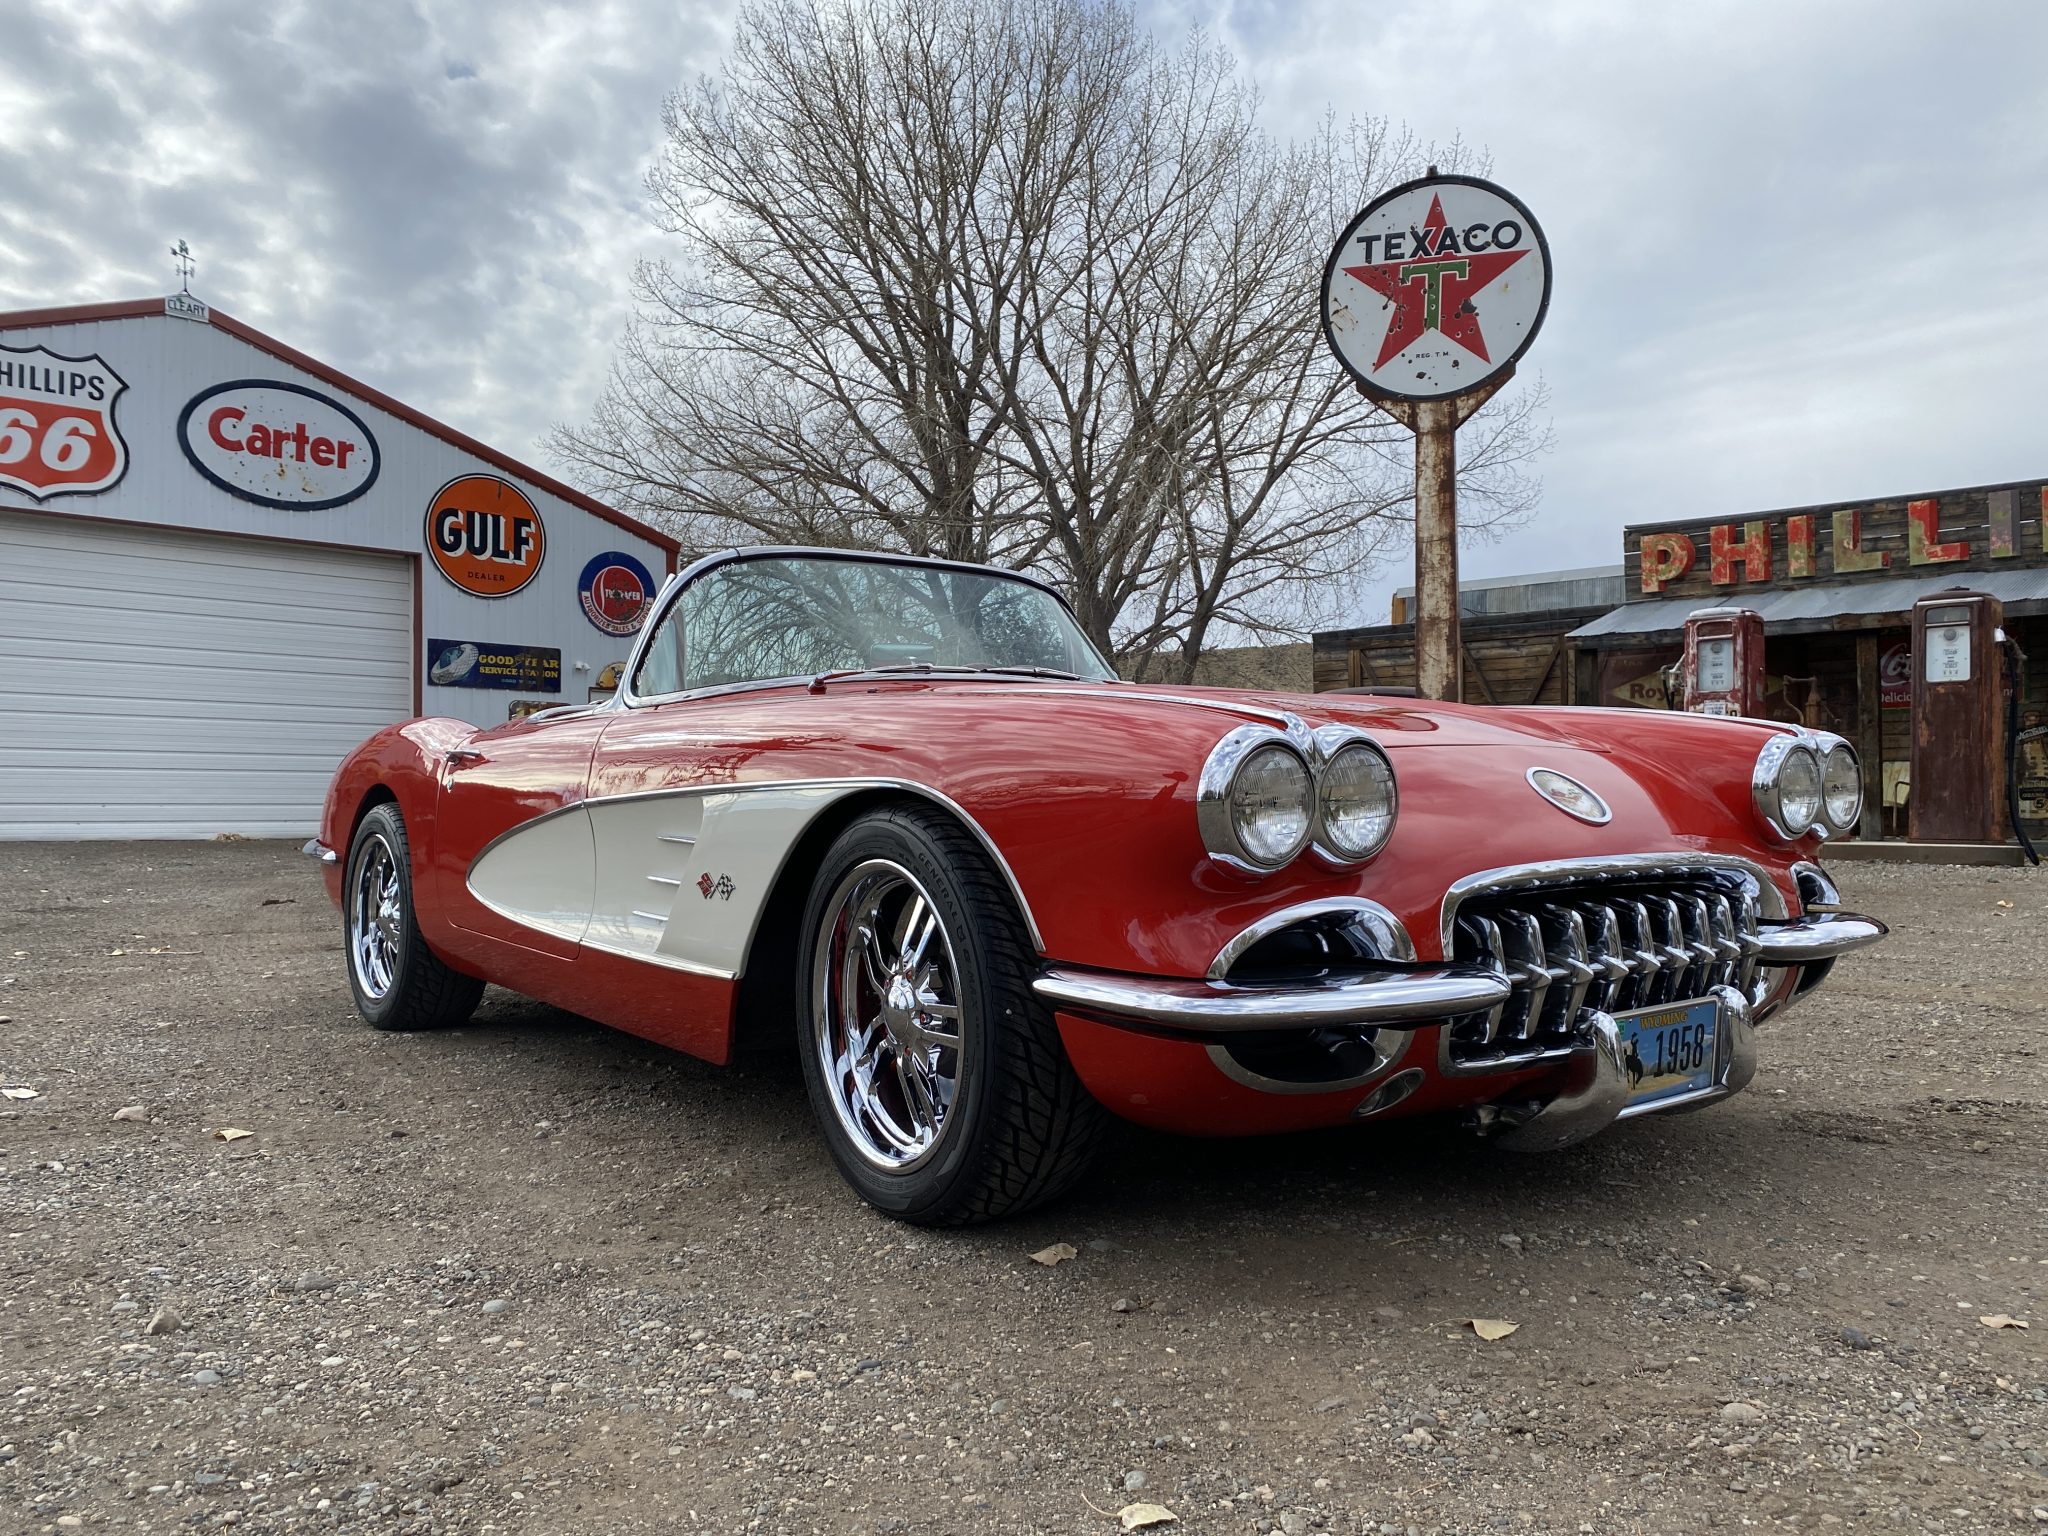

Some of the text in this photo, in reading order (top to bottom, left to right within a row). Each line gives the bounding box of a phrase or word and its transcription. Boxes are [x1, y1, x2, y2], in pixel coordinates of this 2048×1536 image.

[1356, 220, 1522, 264] TEXACO
[167, 298, 206, 315] CLEARY
[1400, 259, 1469, 332] T
[0, 360, 105, 401] HILLIPS
[0, 407, 98, 472] 66
[208, 407, 355, 470] Carter
[435, 508, 536, 566] GULF
[467, 570, 505, 582] DEALER
[691, 563, 734, 588] Corvttes
[637, 601, 653, 625] SERVICE
[479, 666, 518, 676] SERVICE
[918, 852, 959, 922] GENERAL
[1640, 1011, 1688, 1030] WYOMING
[1653, 1023, 1705, 1078] 1958
